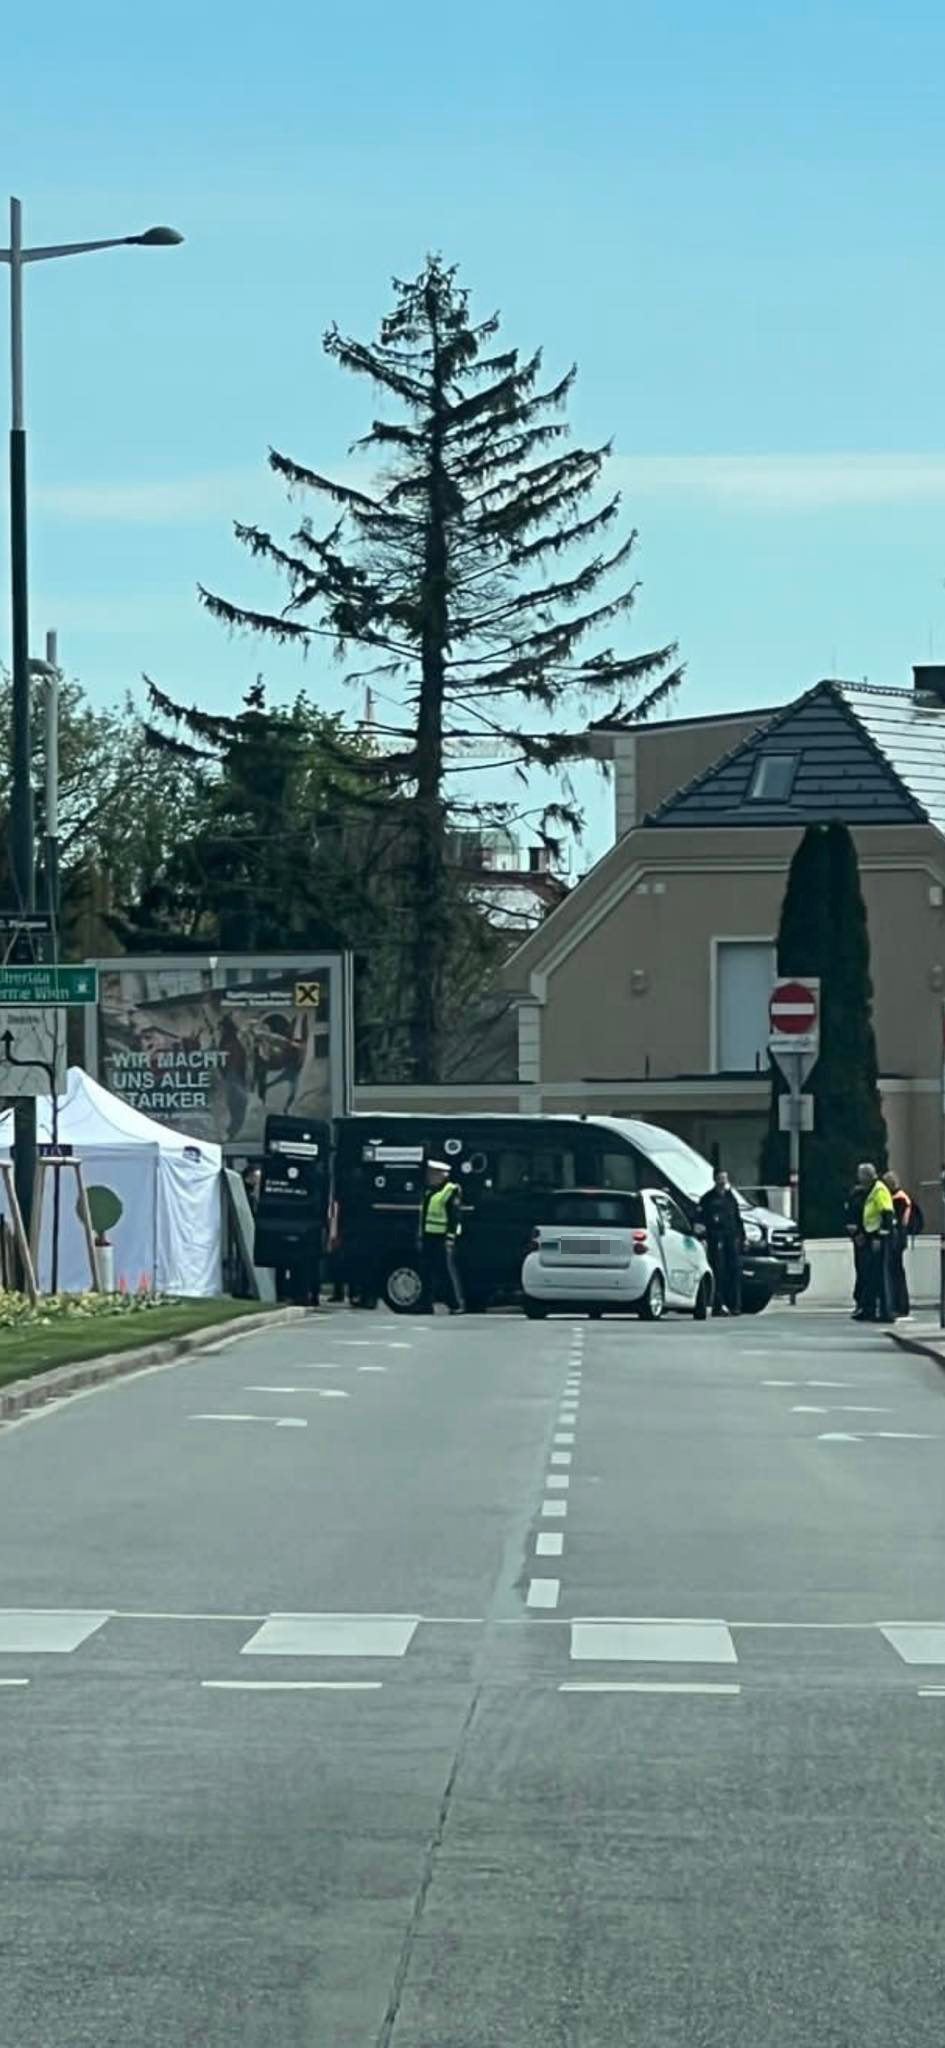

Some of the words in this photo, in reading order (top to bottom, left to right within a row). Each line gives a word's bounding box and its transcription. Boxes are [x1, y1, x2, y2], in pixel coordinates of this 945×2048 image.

[112, 1052, 151, 1068] WIR
[157, 1051, 230, 1068] MACHT
[113, 1072, 154, 1089] UNS
[160, 1072, 211, 1088] ALLE
